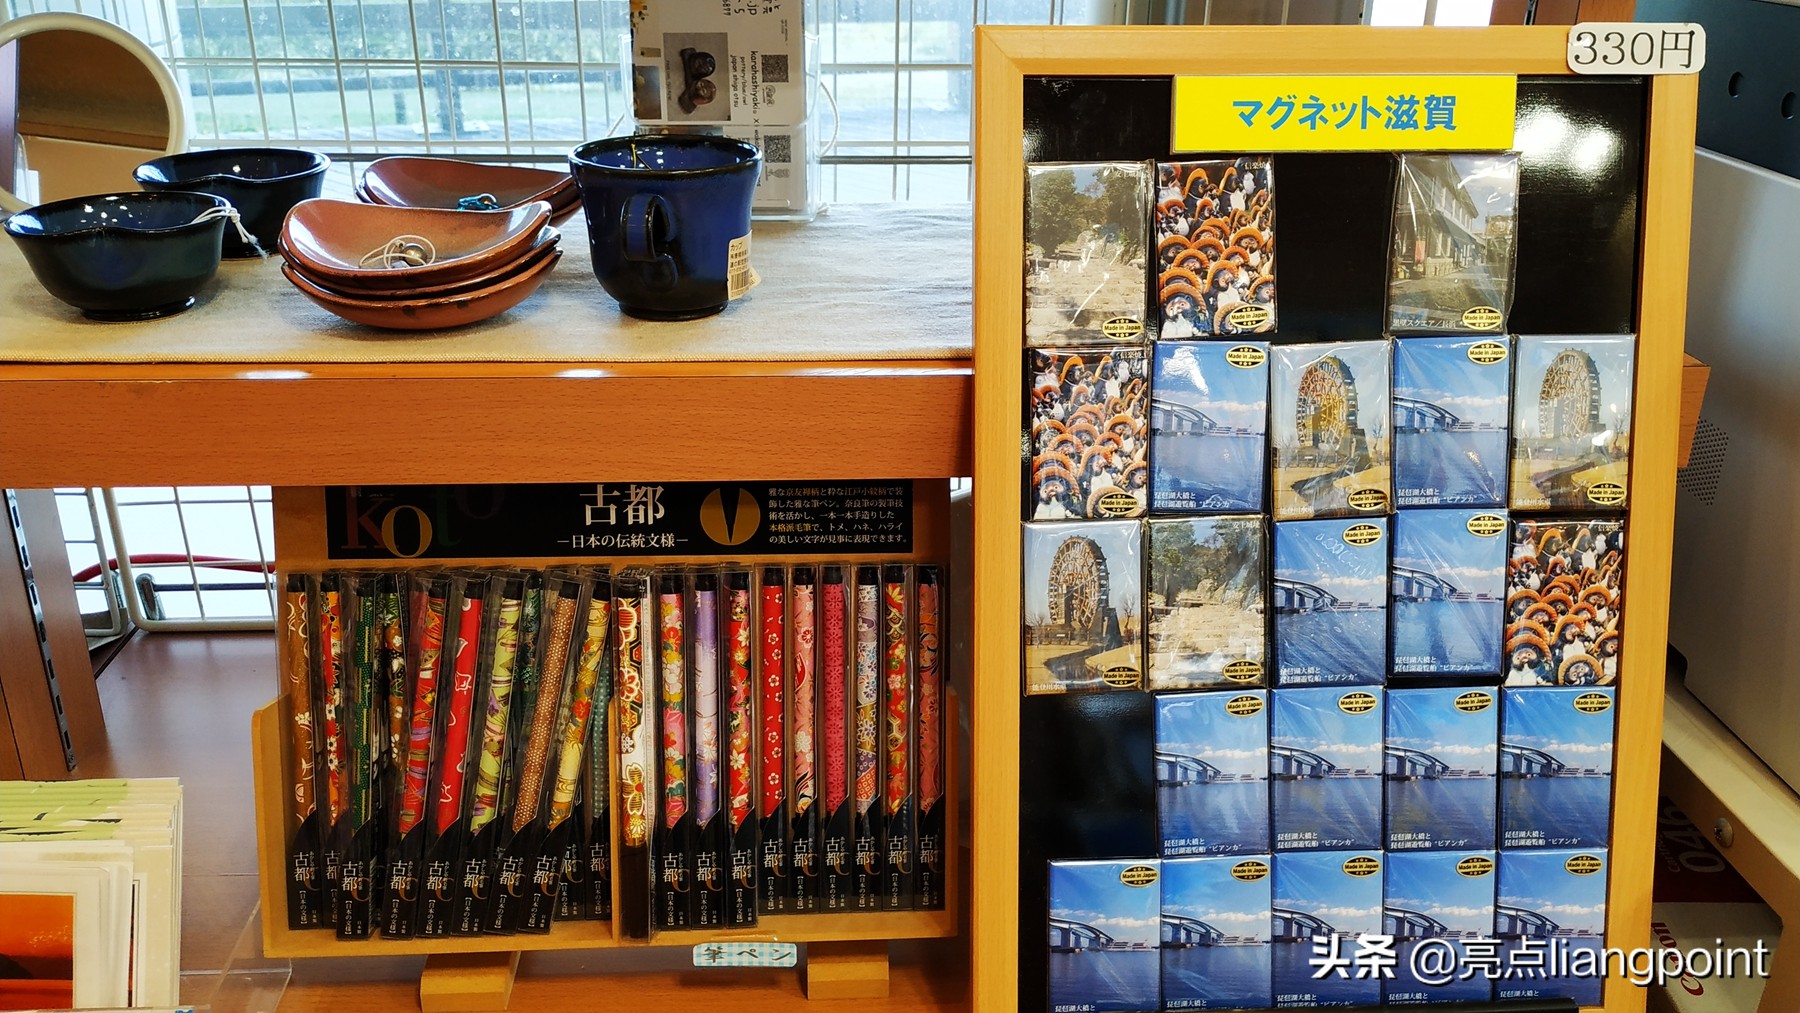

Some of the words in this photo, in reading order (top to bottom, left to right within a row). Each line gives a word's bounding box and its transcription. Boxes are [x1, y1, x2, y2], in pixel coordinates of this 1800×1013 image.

[1574, 30, 1695, 69] 330円
[1232, 94, 1457, 130] マグネット滋賀
[579, 484, 665, 526] 古都
[590, 842, 605, 872] 古都
[763, 839, 778, 868] 古都
[793, 838, 808, 867] 古都
[825, 837, 840, 866] 古都
[855, 836, 870, 866] 古都
[888, 835, 902, 865] 古都
[920, 834, 934, 864] 古都
[293, 852, 309, 881] 古都
[342, 861, 358, 891] 古都
[390, 860, 408, 890] 古都
[426, 860, 444, 891] 古都
[463, 858, 481, 888] 古都
[500, 856, 518, 886] 古都
[533, 854, 552, 885] 古都
[663, 853, 678, 882] 古都
[696, 852, 711, 882] 古都
[731, 850, 746, 880] 古都
[703, 946, 791, 963] 筆ペン
